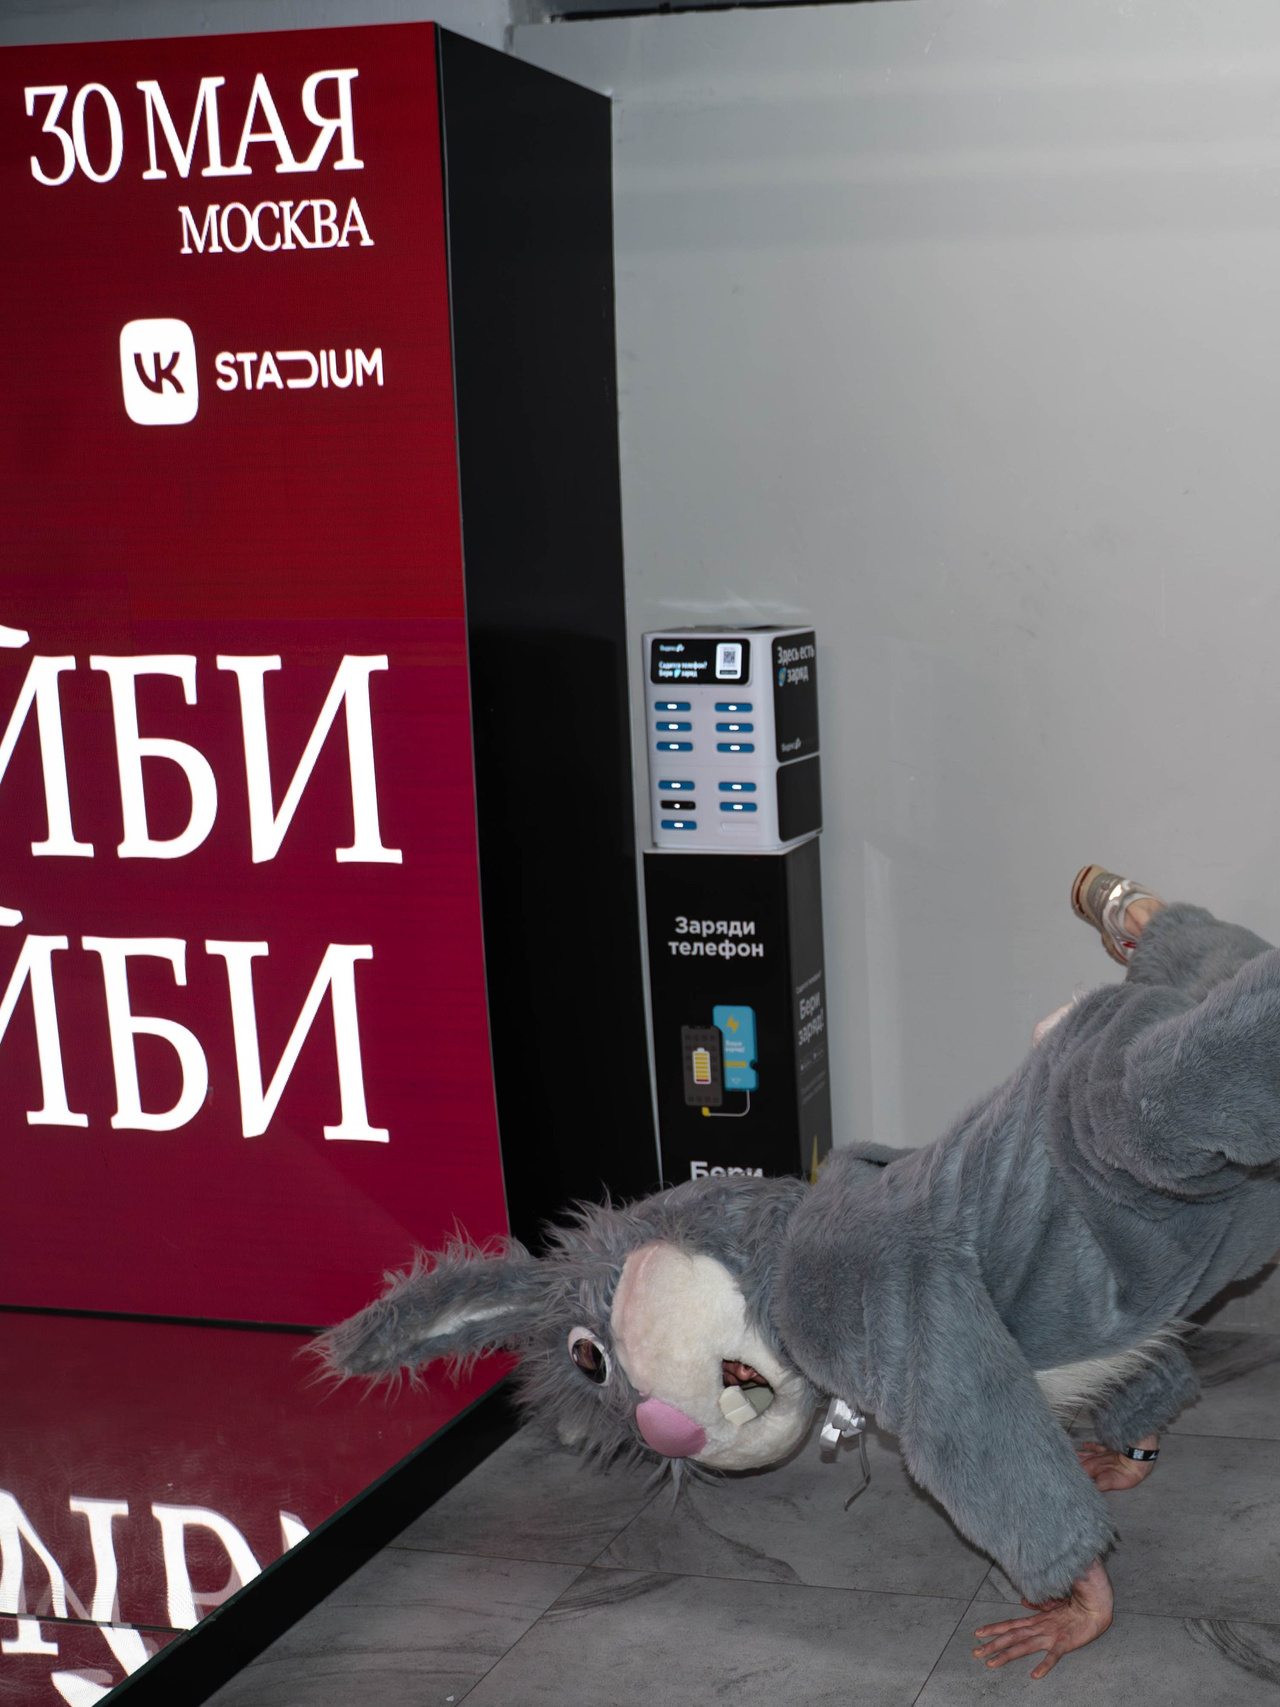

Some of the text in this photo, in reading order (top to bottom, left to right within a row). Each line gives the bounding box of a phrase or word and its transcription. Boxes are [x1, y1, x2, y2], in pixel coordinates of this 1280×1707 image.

[24, 68, 364, 187] 30 МАЯ
[178, 197, 375, 255] МОСКВА
[133, 347, 385, 395] VK STADIUM
[668, 940, 764, 959] телефон
[674, 916, 756, 937] Заряди
